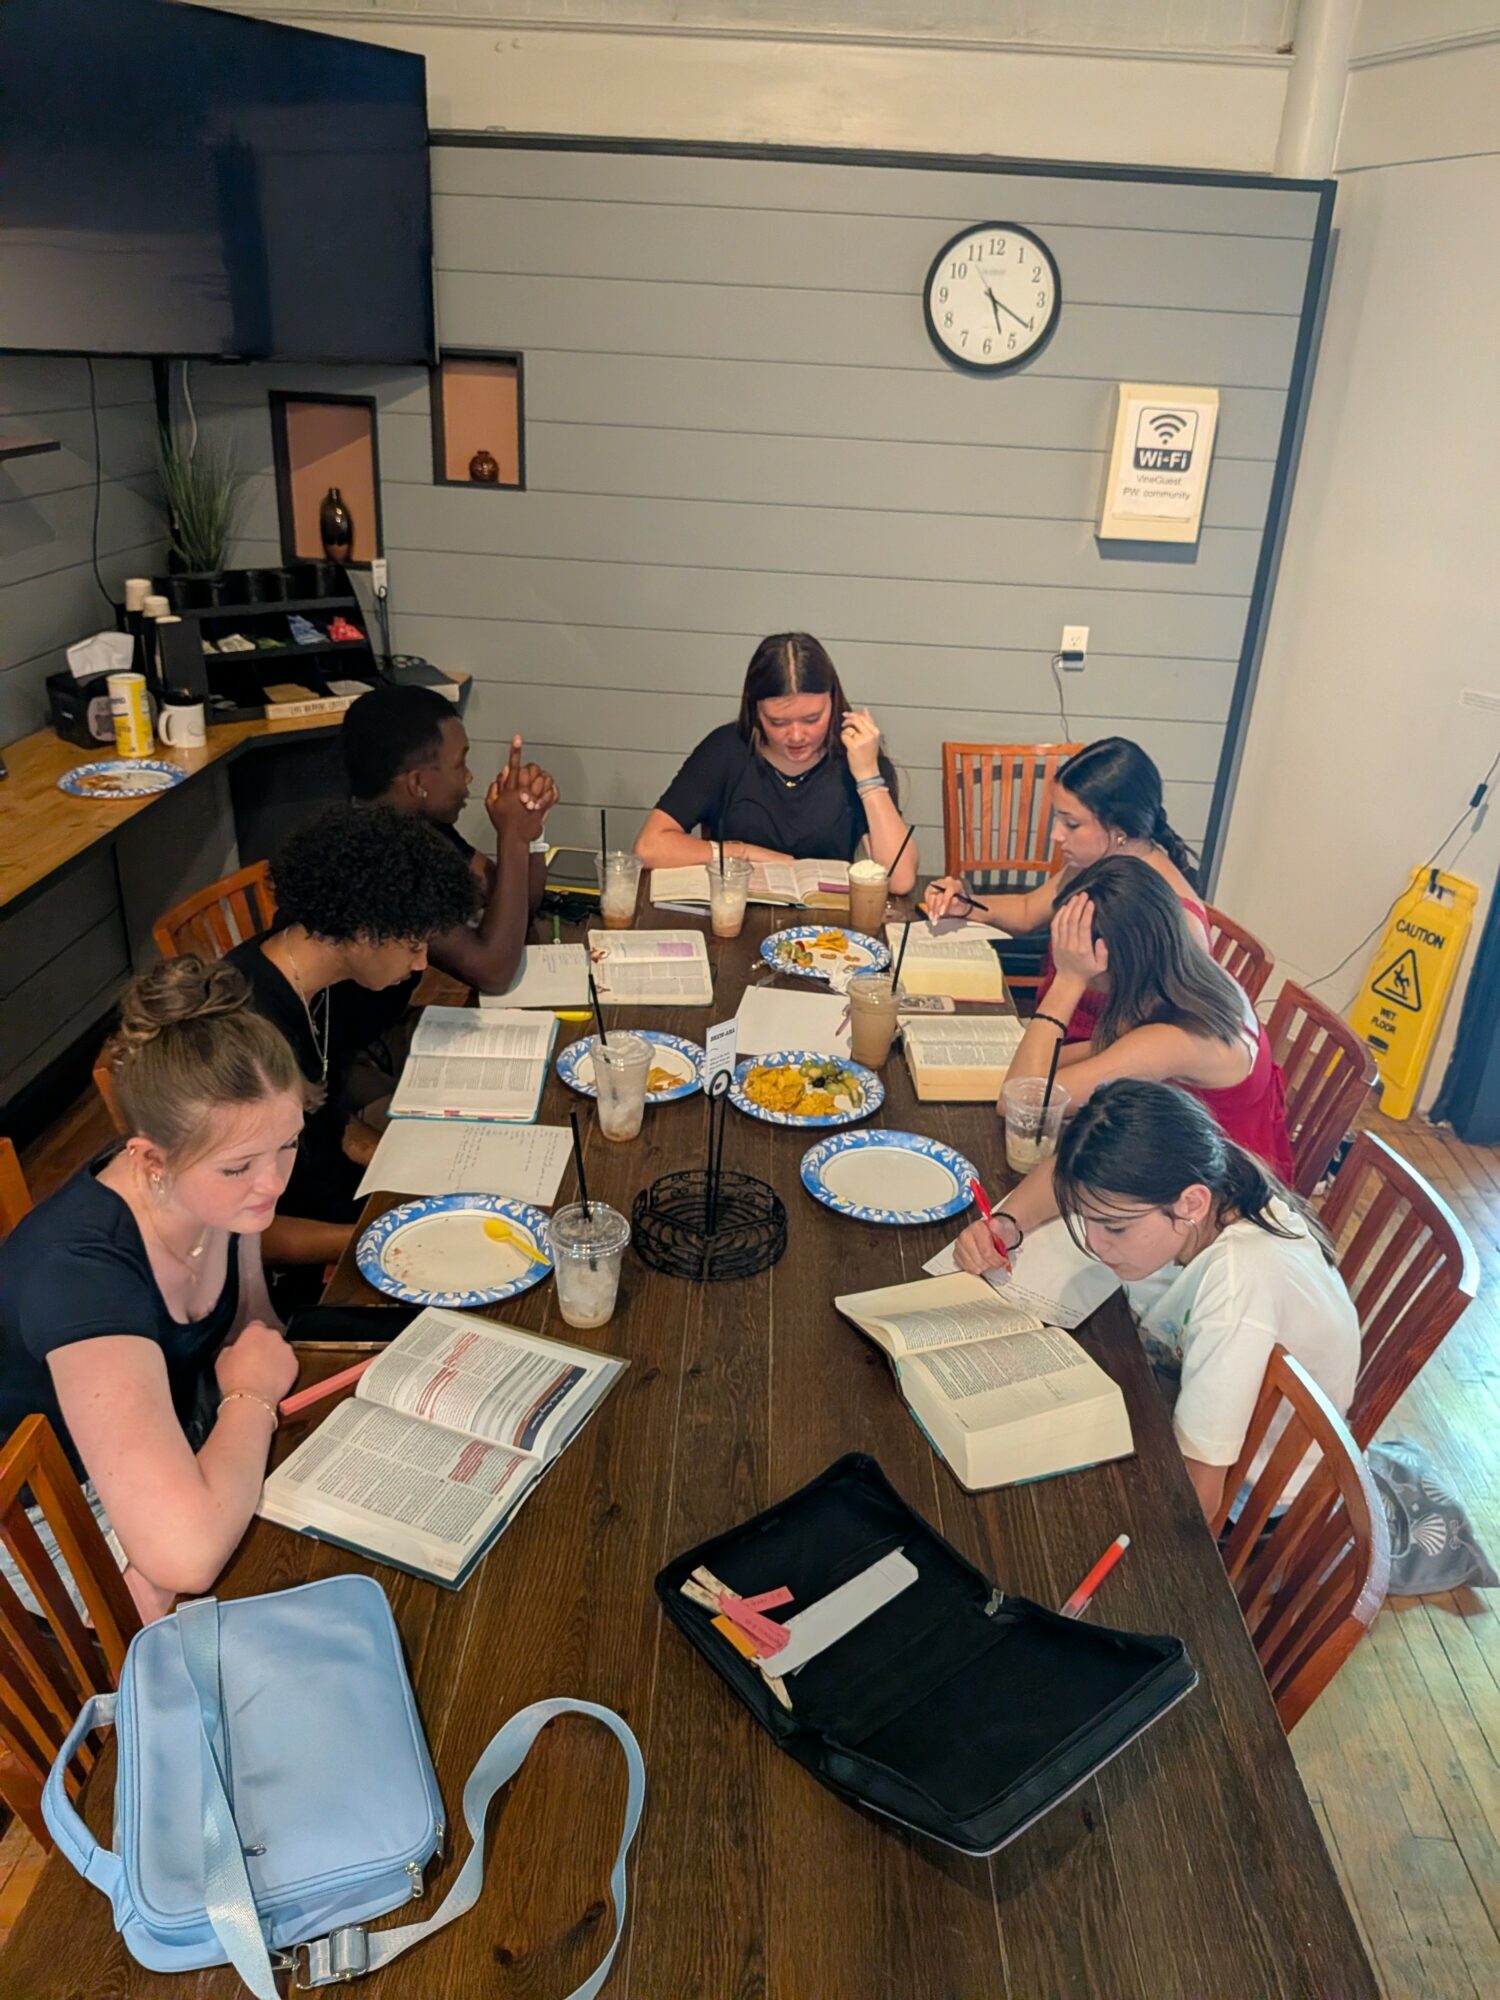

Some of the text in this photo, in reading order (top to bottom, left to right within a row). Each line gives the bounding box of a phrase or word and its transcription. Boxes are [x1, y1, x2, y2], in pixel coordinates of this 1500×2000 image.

[968, 244, 983, 262] 11
[988, 238, 1006, 256] 12
[1017, 246, 1025, 264] 1
[950, 262, 968, 280] 10
[1031, 266, 1042, 283] 2
[939, 287, 949, 304] 9
[1036, 291, 1046, 309] 3
[943, 311, 954, 329] 8
[1025, 315, 1035, 333] 4
[960, 330, 969, 348] 7
[982, 338, 992, 355] 6
[1007, 332, 1017, 350] 5
[1139, 450, 1188, 469] Wi-Fi
[1123, 487, 1190, 501] PW community
[1396, 919, 1445, 950] CAUTION
[1380, 1007, 1397, 1021] WET
[1371, 1015, 1396, 1035] FLOOR
